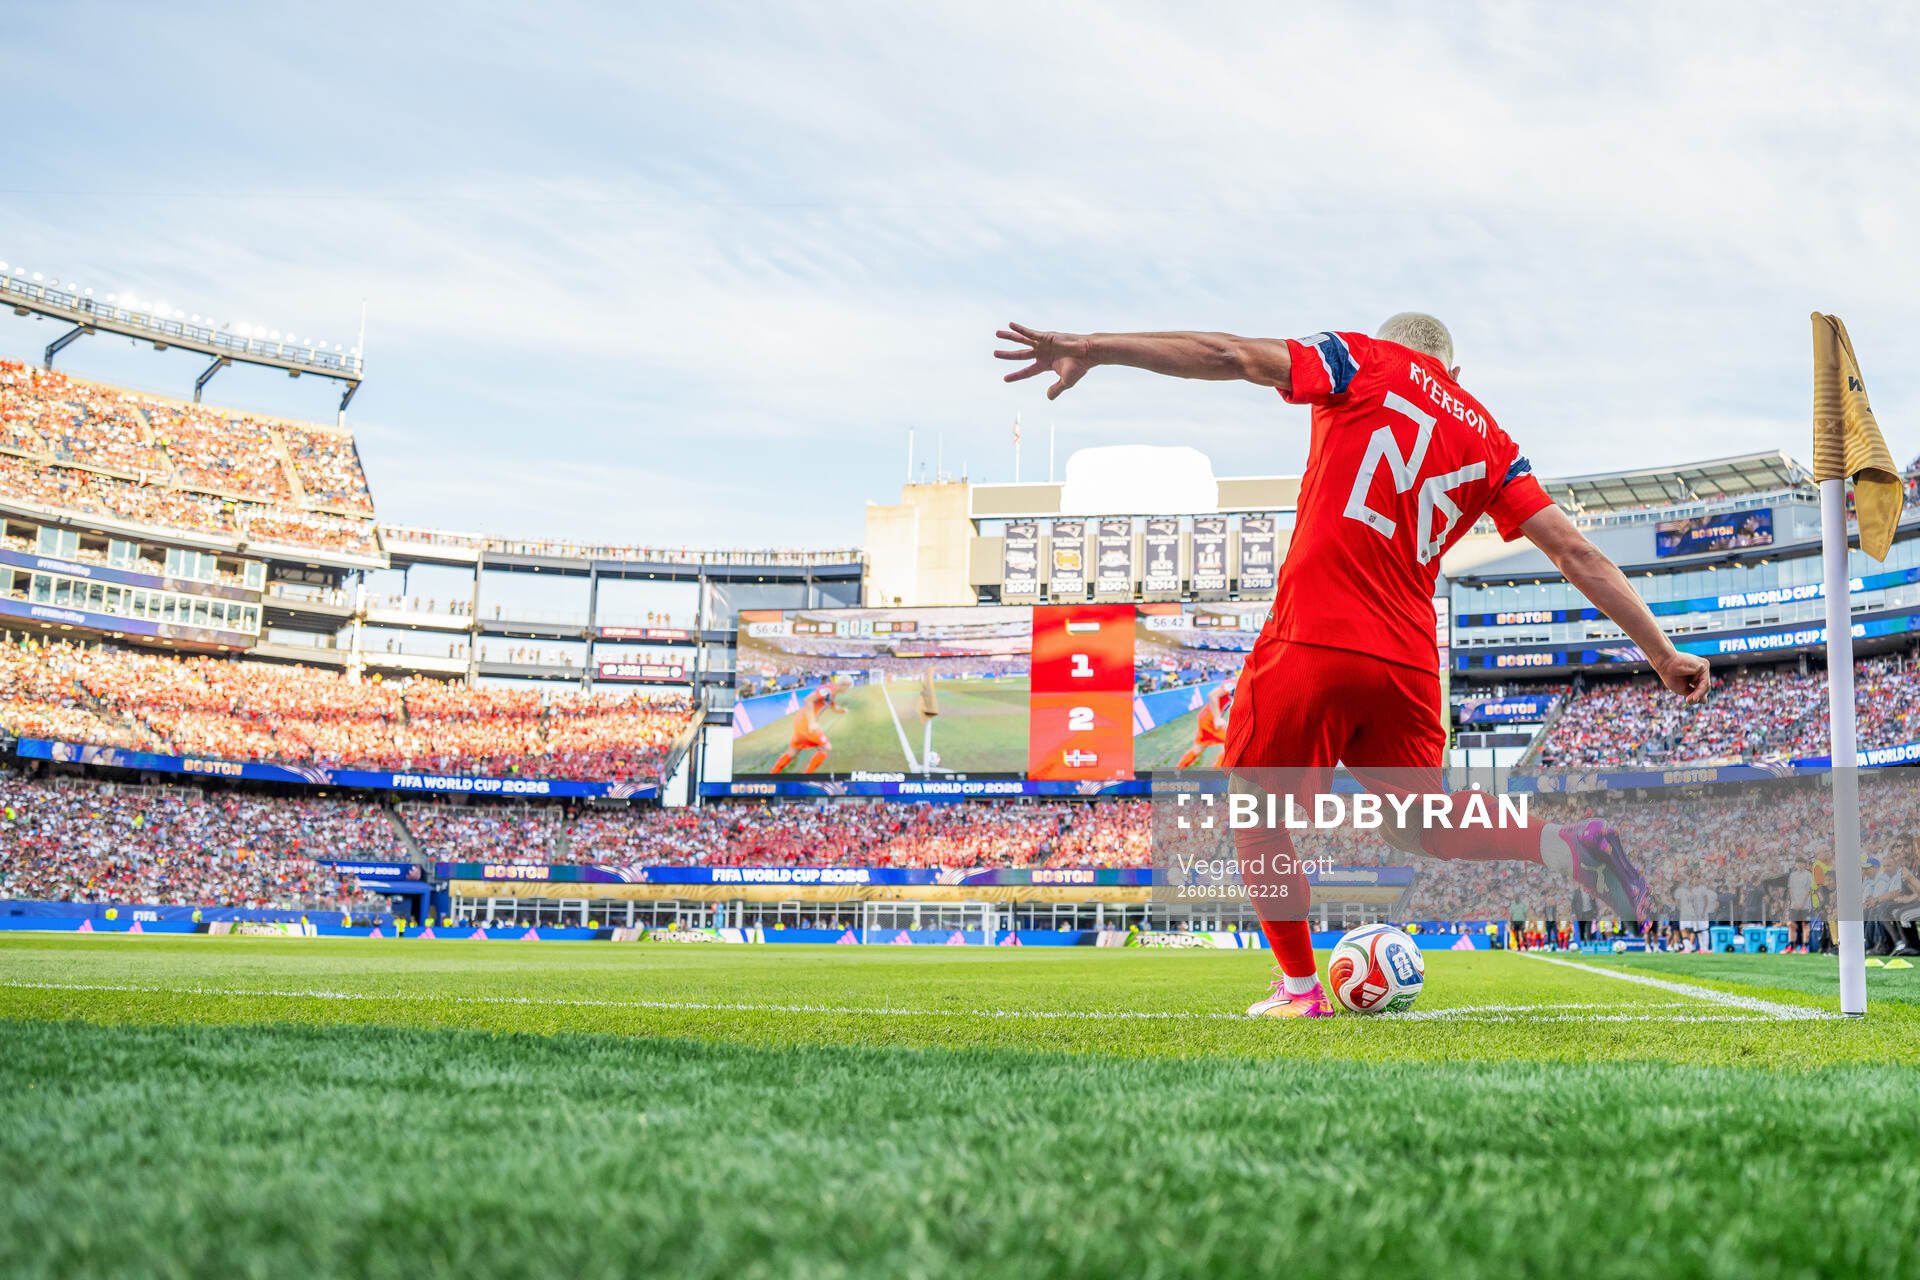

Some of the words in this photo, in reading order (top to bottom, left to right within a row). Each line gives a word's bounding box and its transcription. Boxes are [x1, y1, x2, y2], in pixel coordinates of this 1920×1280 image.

[1409, 361, 1487, 439] RYERSON
[1343, 390, 1486, 566] 26
[1692, 526, 1734, 539] BOSTON
[1718, 594, 1746, 608] FIFA
[1746, 588, 1793, 605] WORLD
[1793, 584, 1818, 600] CUP
[1497, 611, 1552, 624] BOSTON
[755, 625, 785, 635] 56:42
[1719, 639, 1748, 652] FIFA
[1748, 633, 1794, 650] WORLD
[1795, 629, 1820, 645] CUP
[1071, 654, 1094, 677] 1
[1497, 653, 1552, 667] BOSTON
[1485, 703, 1536, 715] BOSTON
[1069, 707, 1094, 731] 2
[1868, 746, 1905, 764] WORLD
[184, 759, 243, 776] BOSTON
[852, 771, 905, 783] Hisense
[1663, 768, 1718, 784] BOSTON
[393, 775, 423, 788] FIFA
[424, 776, 473, 791] WORLD
[474, 778, 502, 792] CUP
[502, 781, 549, 794] 2026
[730, 784, 776, 795] BOSTON
[899, 783, 922, 794] FIFA
[922, 783, 961, 794] WORLD
[962, 783, 984, 794] CUP
[985, 783, 1023, 794] 2026
[1152, 782, 1200, 793] BOSTON
[484, 865, 549, 879] BOSTON
[712, 869, 742, 883] FIFA
[742, 869, 791, 883] WORLD
[792, 869, 820, 883] CUP
[820, 869, 869, 883] 2026
[1031, 870, 1094, 883] BOSTON
[133, 911, 157, 922] FIFA
[1137, 934, 1204, 948] TRIONDA
